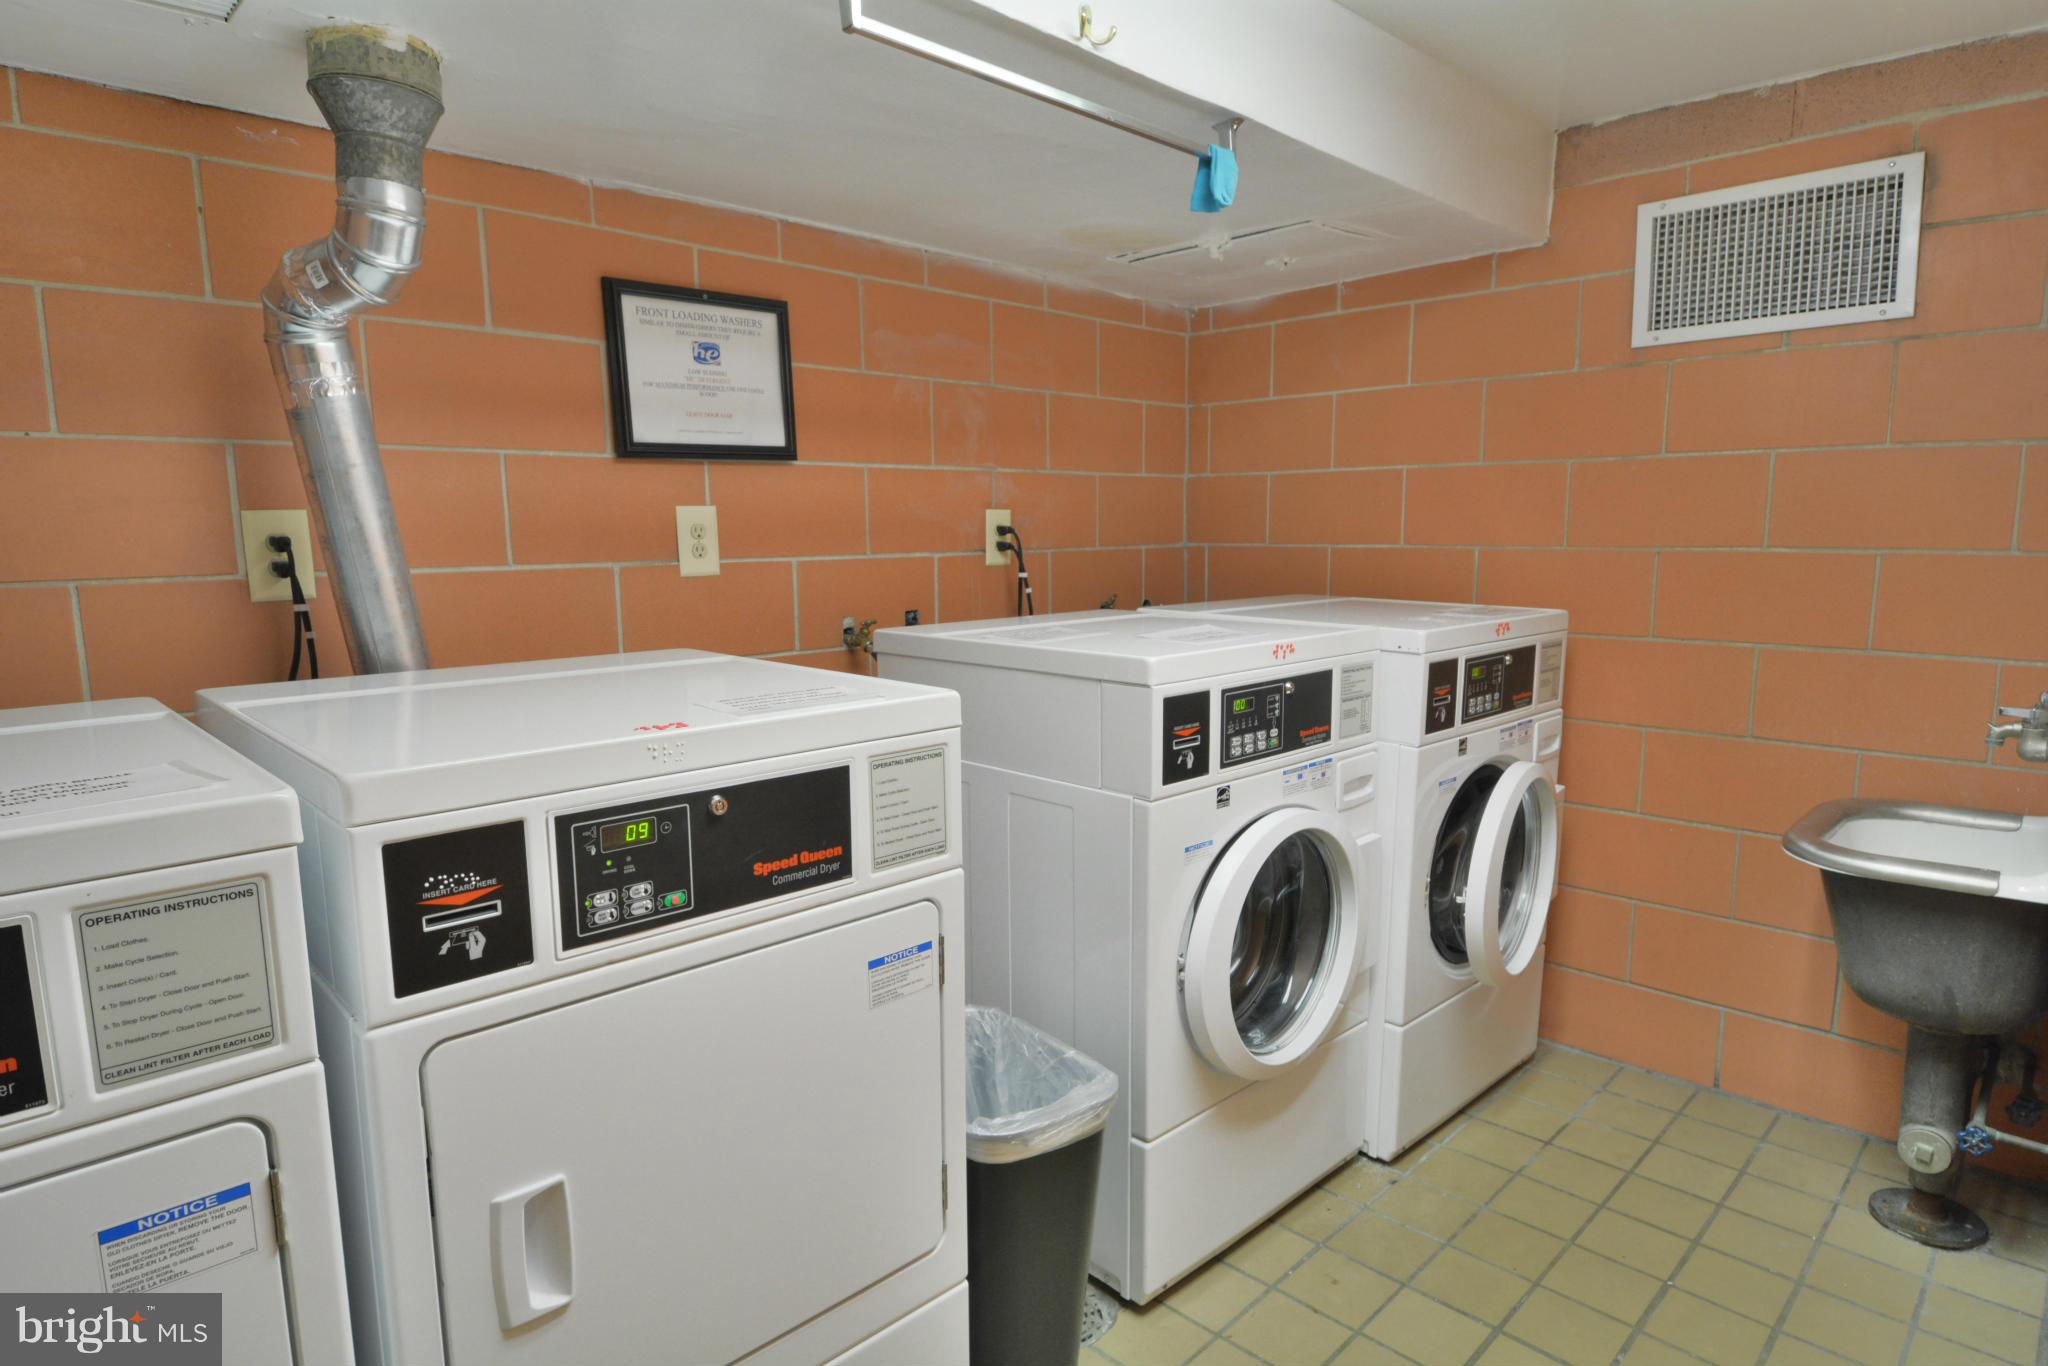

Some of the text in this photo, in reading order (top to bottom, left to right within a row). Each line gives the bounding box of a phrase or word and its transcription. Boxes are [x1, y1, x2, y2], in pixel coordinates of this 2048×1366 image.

[635, 305, 762, 328] FRONT LOADING WASHERS
[873, 751, 941, 769] OPERATING INSTRUCTIONS
[625, 822, 650, 841] 09
[753, 846, 843, 876] Speed Queen
[772, 860, 841, 886] Commercial Dryer
[422, 877, 498, 900] INSERT CARD HERE
[84, 887, 254, 928] OPERATING INSTRUCTIONS
[101, 942, 119, 950] Load
[885, 946, 918, 963] NOTICE
[103, 961, 123, 970] Make
[124, 956, 144, 967] Cycle
[106, 980, 126, 989] Insert
[119, 998, 136, 1007] Start
[137, 993, 157, 1004] Dryer
[162, 987, 182, 996] Close
[183, 983, 199, 991] Door
[215, 975, 232, 984] Push
[121, 1017, 138, 1027] Stop
[139, 1012, 158, 1023] Dryer
[160, 1006, 182, 1018] During
[183, 1001, 202, 1012] Cycle
[208, 996, 226, 1006] Open
[124, 1034, 149, 1045] Restart
[151, 1029, 170, 1040] Dryer
[175, 1022, 195, 1032] Close
[196, 1018, 212, 1027] Door
[213, 1014, 226, 1022] and
[227, 1010, 244, 1019] Push
[104, 1030, 270, 1081] CLEAN LINT FILTER AFTER EACH LOAD
[137, 1195, 218, 1230] NOTICE
[106, 1248, 120, 1257] OLD
[122, 1238, 151, 1252] CLOTHES
[178, 1217, 208, 1232] REMOVE
[210, 1212, 224, 1221] THE
[140, 1246, 158, 1256] VOUS
[158, 1254, 167, 1262] LA
